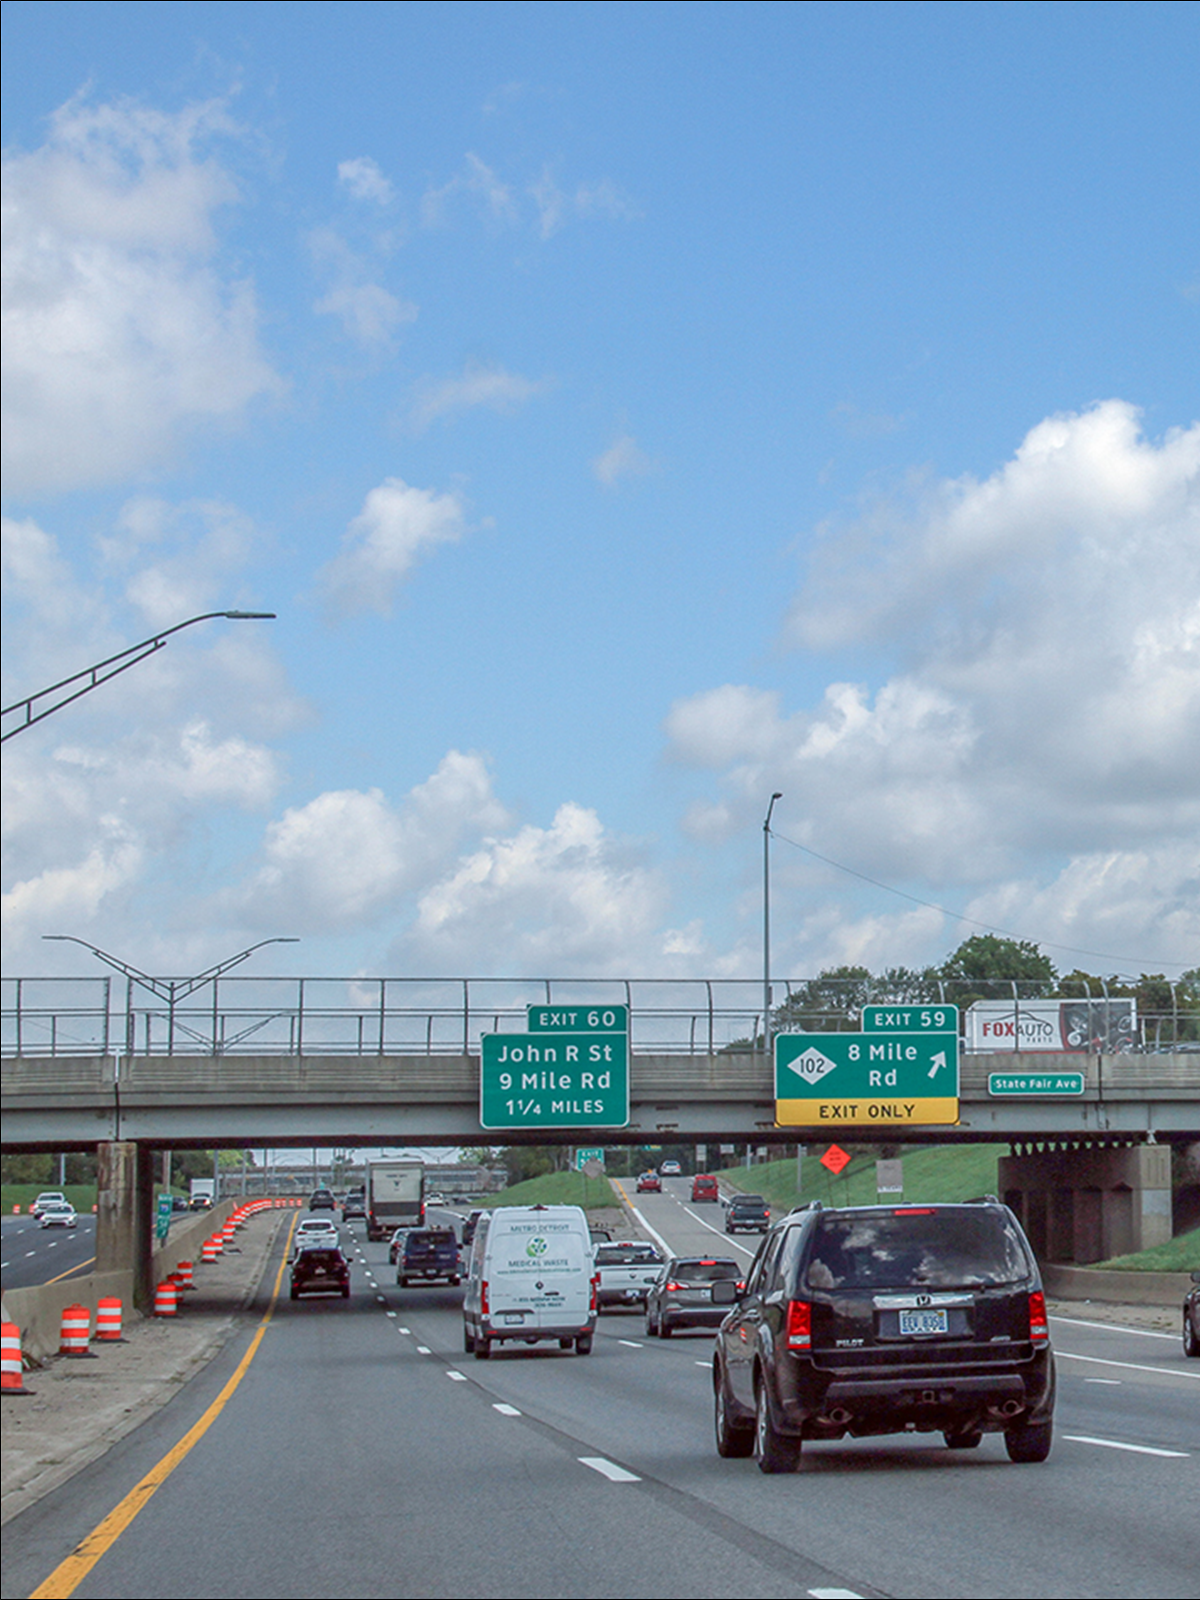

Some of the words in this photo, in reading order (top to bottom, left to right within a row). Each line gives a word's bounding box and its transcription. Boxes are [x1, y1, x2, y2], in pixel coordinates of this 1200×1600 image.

[539, 1012, 577, 1026] EXIT
[587, 1011, 616, 1027] 60
[874, 1013, 912, 1026] EXIT
[920, 1011, 945, 1027] 59
[497, 1045, 557, 1063] John
[566, 1045, 579, 1062] R
[589, 1044, 613, 1062] St
[848, 1044, 861, 1061] 8
[869, 1043, 918, 1061] Mile
[800, 1058, 825, 1074] 102
[499, 1072, 513, 1090] 9
[521, 1071, 572, 1090] Mile
[581, 1071, 611, 1089] Rd
[869, 1068, 897, 1087] Rd
[995, 1078, 1027, 1089] State
[1029, 1078, 1052, 1089] Fair
[1055, 1079, 1077, 1089] Ave
[551, 1099, 604, 1114] MILES
[819, 1105, 858, 1119] EXIT
[868, 1104, 916, 1119] ONLY
